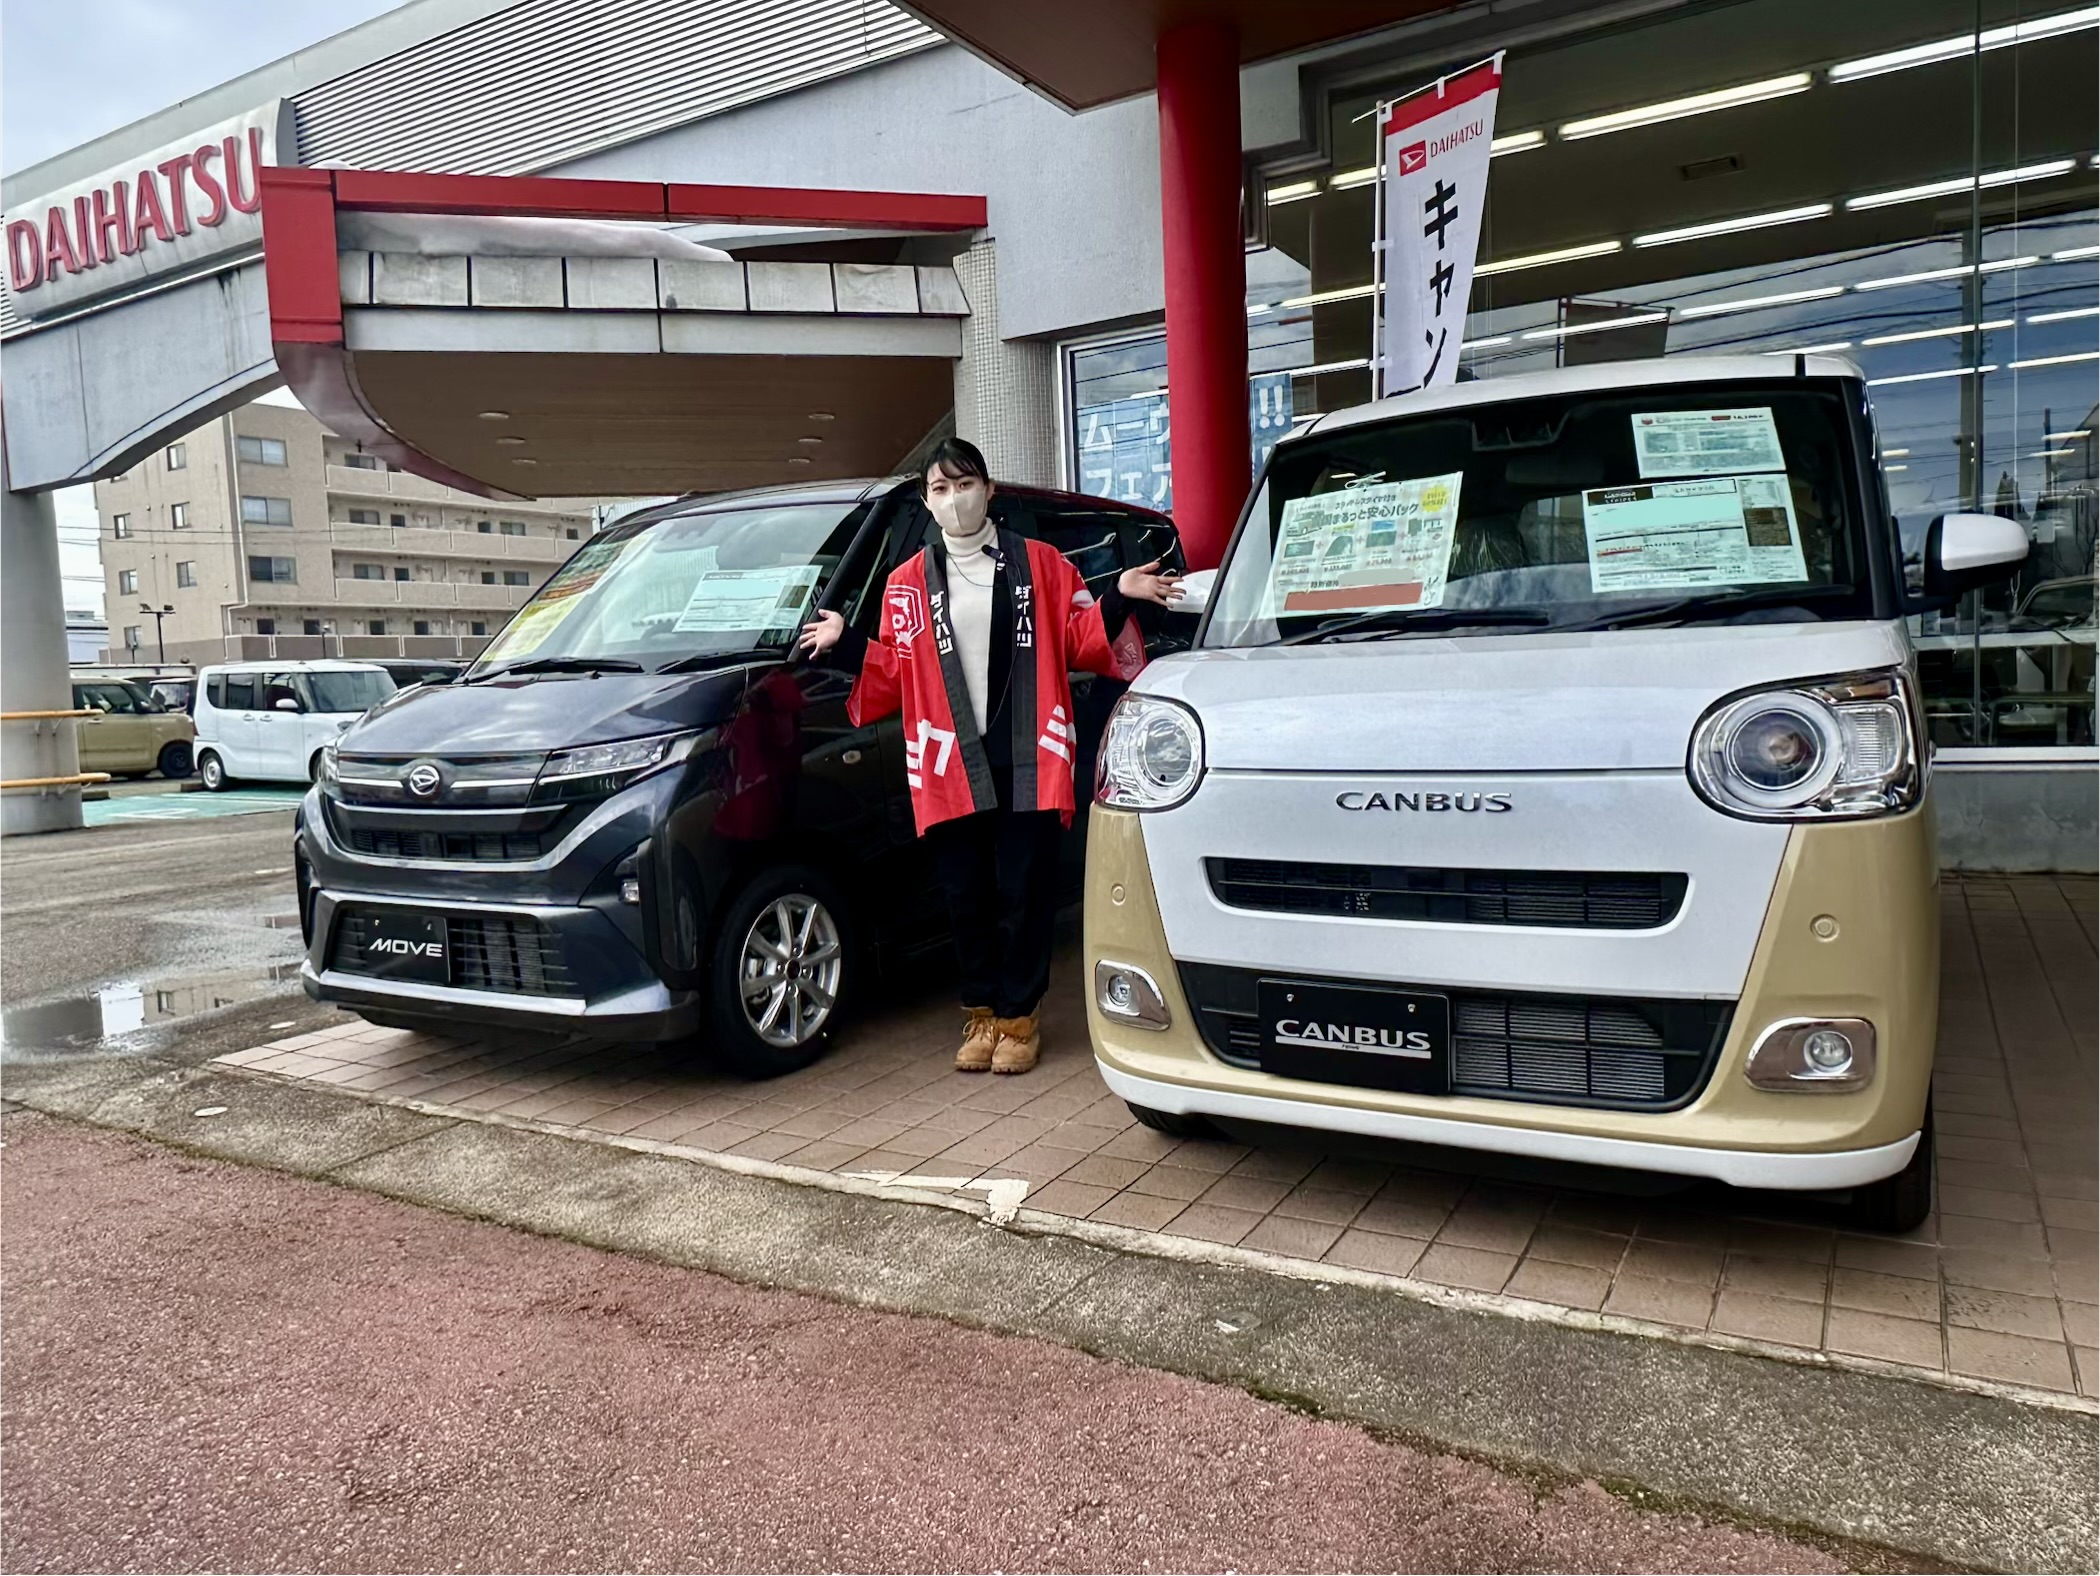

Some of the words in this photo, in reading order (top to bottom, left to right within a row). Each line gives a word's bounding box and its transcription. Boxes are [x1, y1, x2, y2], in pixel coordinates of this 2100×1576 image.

[1431, 118, 1483, 158] DAIHATSU
[6, 126, 262, 292] DAIHATSU
[1335, 791, 1513, 813] CANBUS
[369, 937, 443, 958] MOVE
[1275, 1018, 1432, 1051] CANBUS
